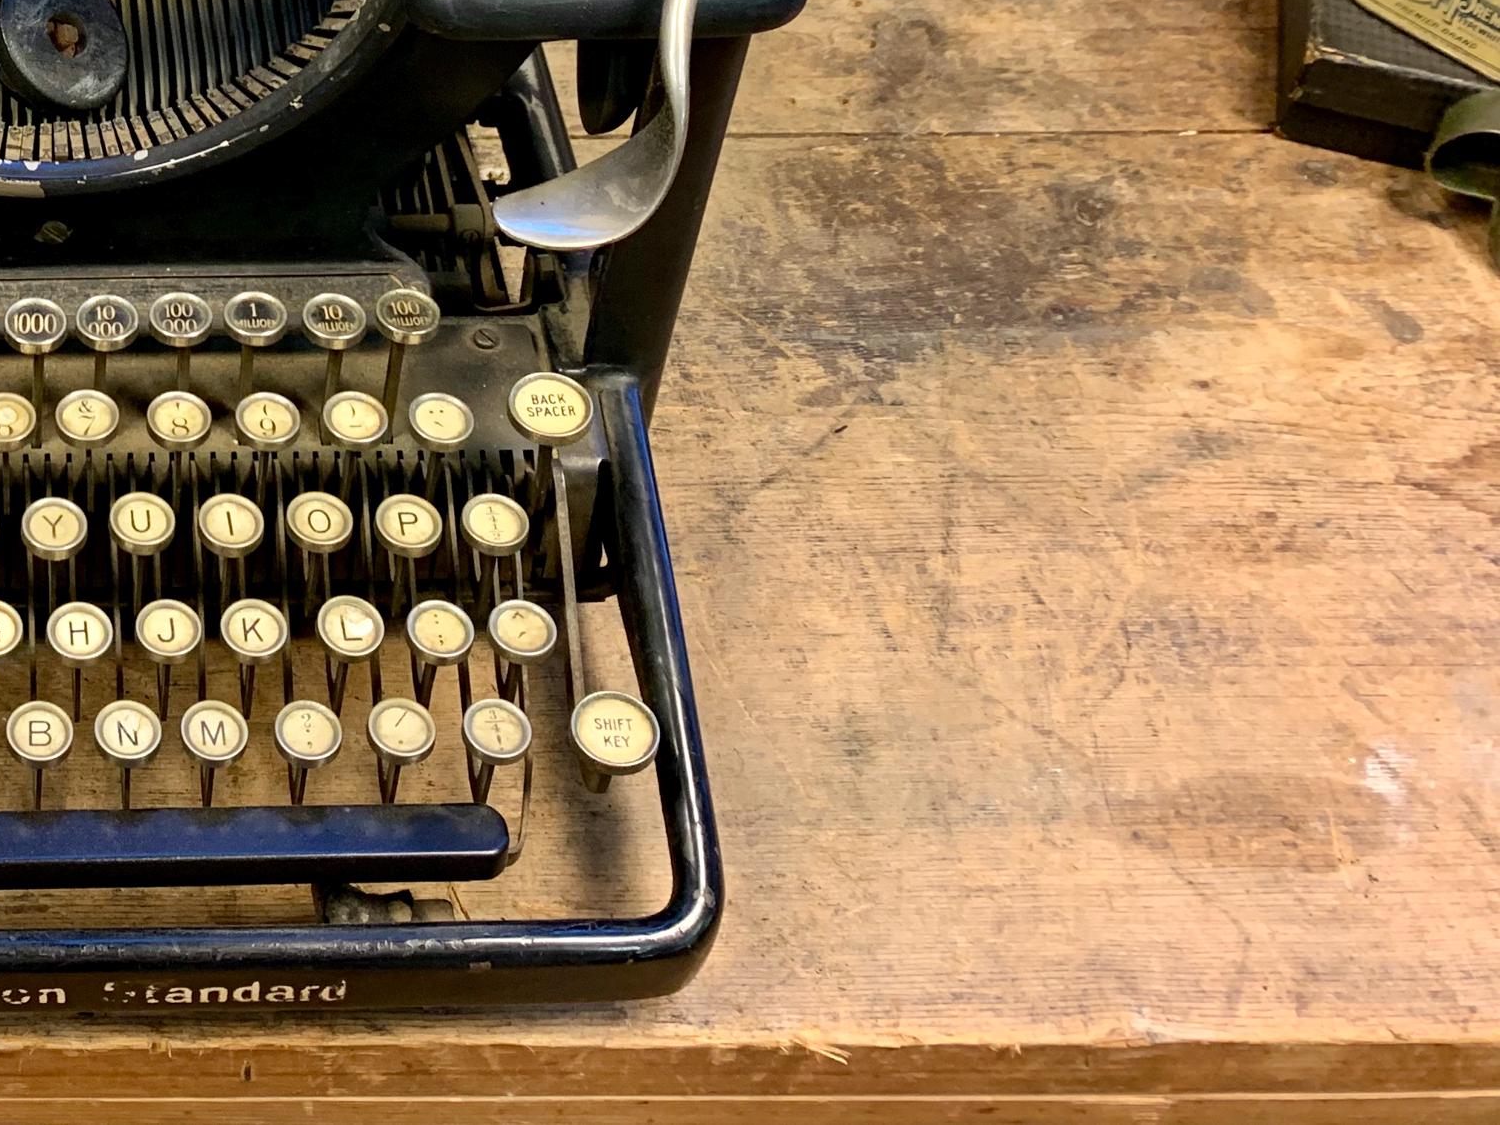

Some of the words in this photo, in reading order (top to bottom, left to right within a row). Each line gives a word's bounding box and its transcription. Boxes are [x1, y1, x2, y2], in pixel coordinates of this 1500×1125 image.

[95, 305, 117, 321] 10
[164, 302, 194, 318] 100
[322, 305, 343, 320] 10
[390, 300, 420, 316] 100
[13, 313, 57, 335] 1000
[531, 393, 567, 405] BACK
[527, 404, 576, 418] SPACER
[78, 415, 97, 436] 7
[171, 417, 190, 436] 8
[259, 417, 276, 435] 9
[42, 514, 63, 539] Y
[130, 509, 150, 533] U
[226, 511, 234, 536] I
[307, 509, 331, 534] O
[397, 511, 418, 536] P
[68, 620, 89, 646] H
[157, 617, 175, 643] J
[242, 617, 263, 643] K
[339, 613, 363, 641] L
[28, 720, 52, 747] B
[117, 720, 139, 747] N
[200, 720, 227, 747] M
[594, 718, 632, 732] SHIFT
[603, 735, 630, 748] KEY
